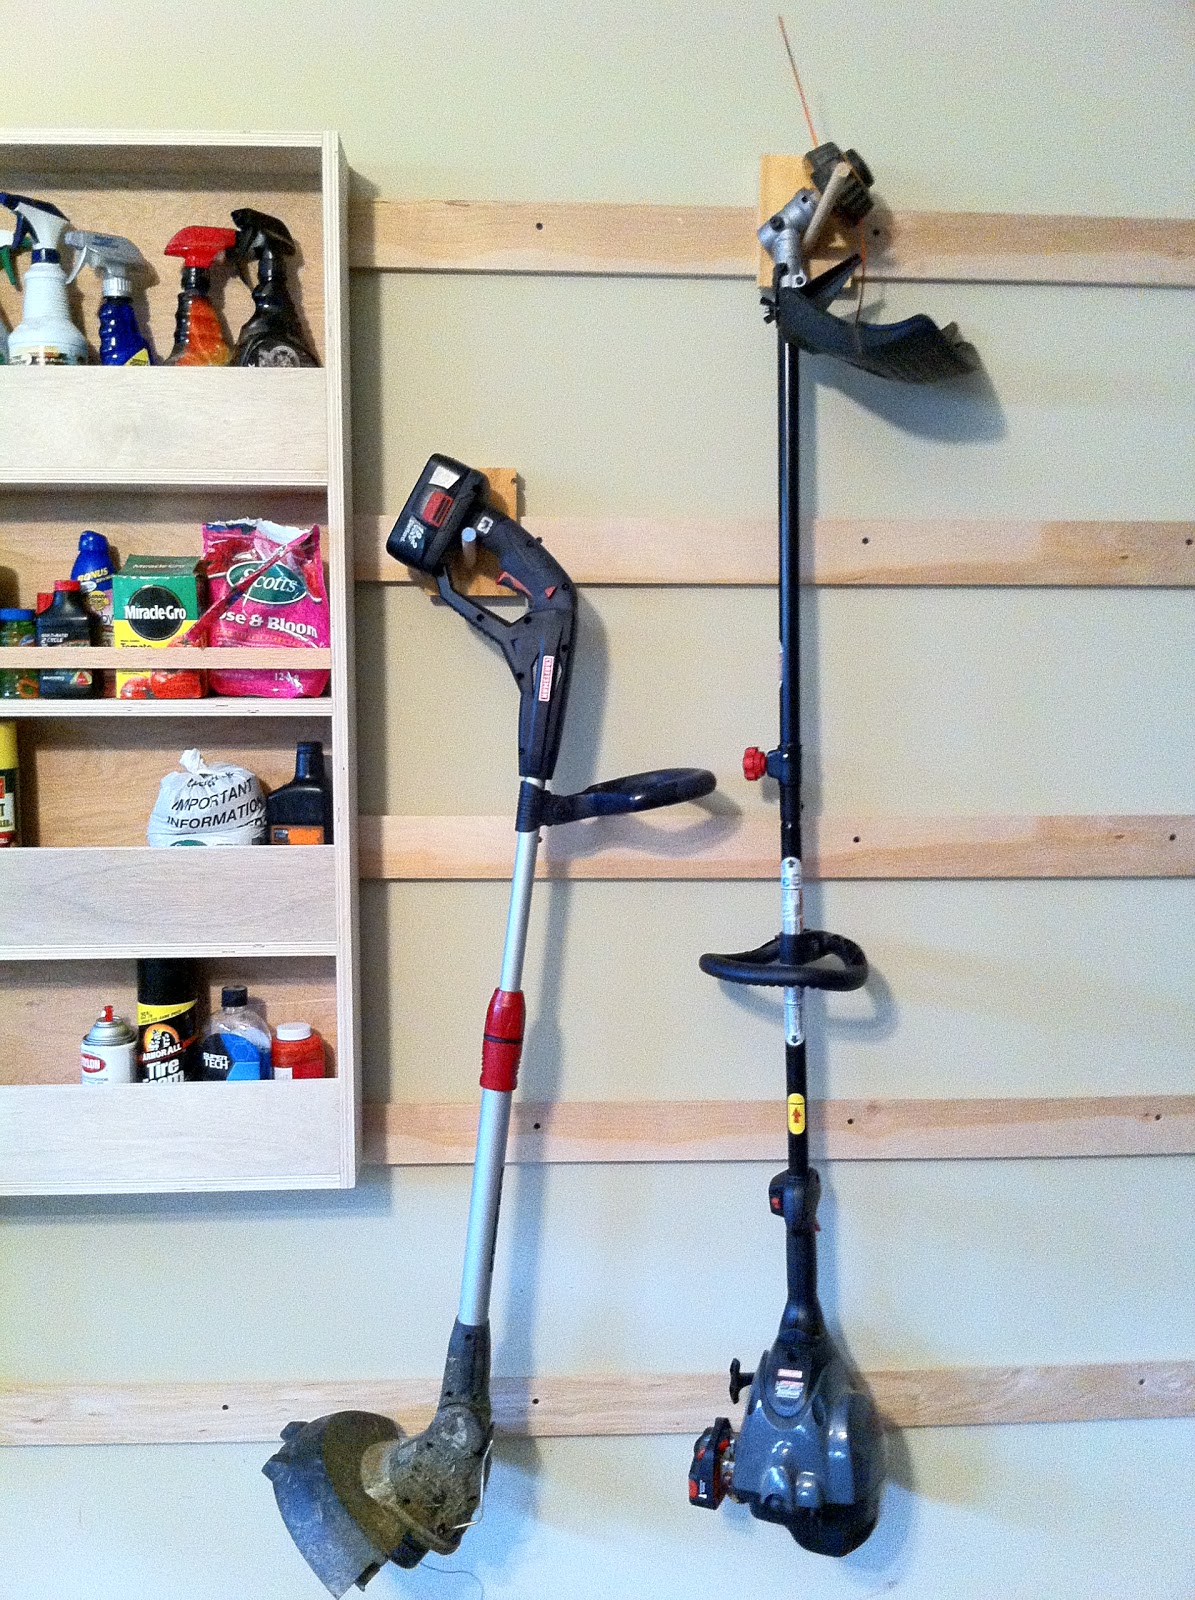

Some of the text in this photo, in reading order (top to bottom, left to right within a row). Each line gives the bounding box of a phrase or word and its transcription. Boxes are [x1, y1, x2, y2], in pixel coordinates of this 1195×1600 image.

[77, 567, 109, 582] BONUS
[219, 611, 247, 625] se
[249, 614, 264, 627] &
[267, 616, 318, 639] Bloom
[171, 778, 252, 813] IMPORTANT
[147, 1059, 180, 1080] Tire
[205, 1059, 229, 1070] TECH
